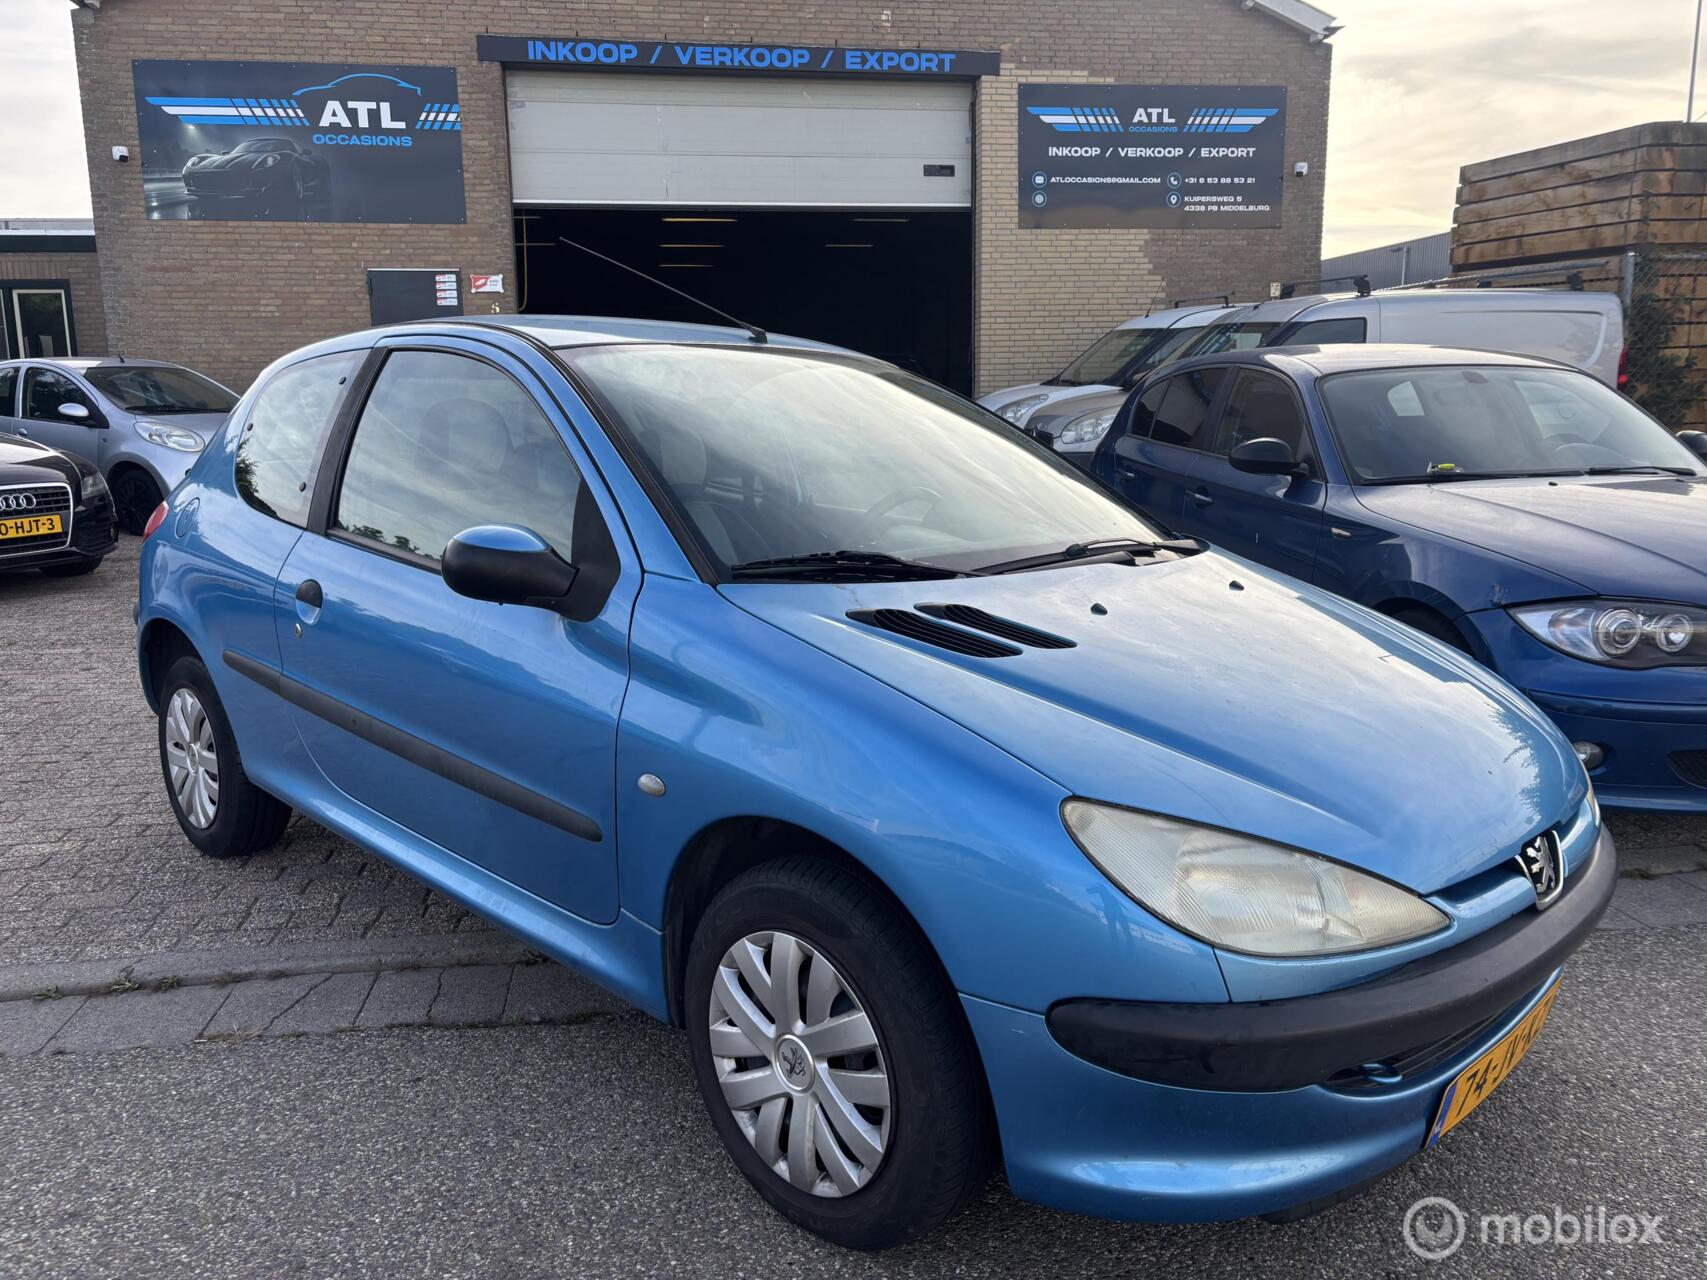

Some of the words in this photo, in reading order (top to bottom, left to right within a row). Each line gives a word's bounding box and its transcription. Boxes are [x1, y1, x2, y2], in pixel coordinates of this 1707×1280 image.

[526, 39, 639, 65] INKOOP
[650, 45, 662, 65] /
[673, 45, 812, 69] VERKOOP
[820, 49, 833, 69] /
[843, 49, 957, 73] EXPORT
[318, 100, 407, 129] ATL
[1132, 107, 1176, 124] ATL
[311, 132, 414, 148] OCCASIONS
[1048, 146, 1101, 157] INKOOP
[1105, 147, 1114, 158] /
[1117, 147, 1184, 158] VERKOOP
[1188, 147, 1197, 158] /
[1200, 147, 1257, 158] EXPORT
[1050, 176, 1161, 184] ATLOCCASIONS@GMAIL.COM
[1183, 195, 1235, 203] KUIPERSWEG
[490, 302, 501, 314] 5
